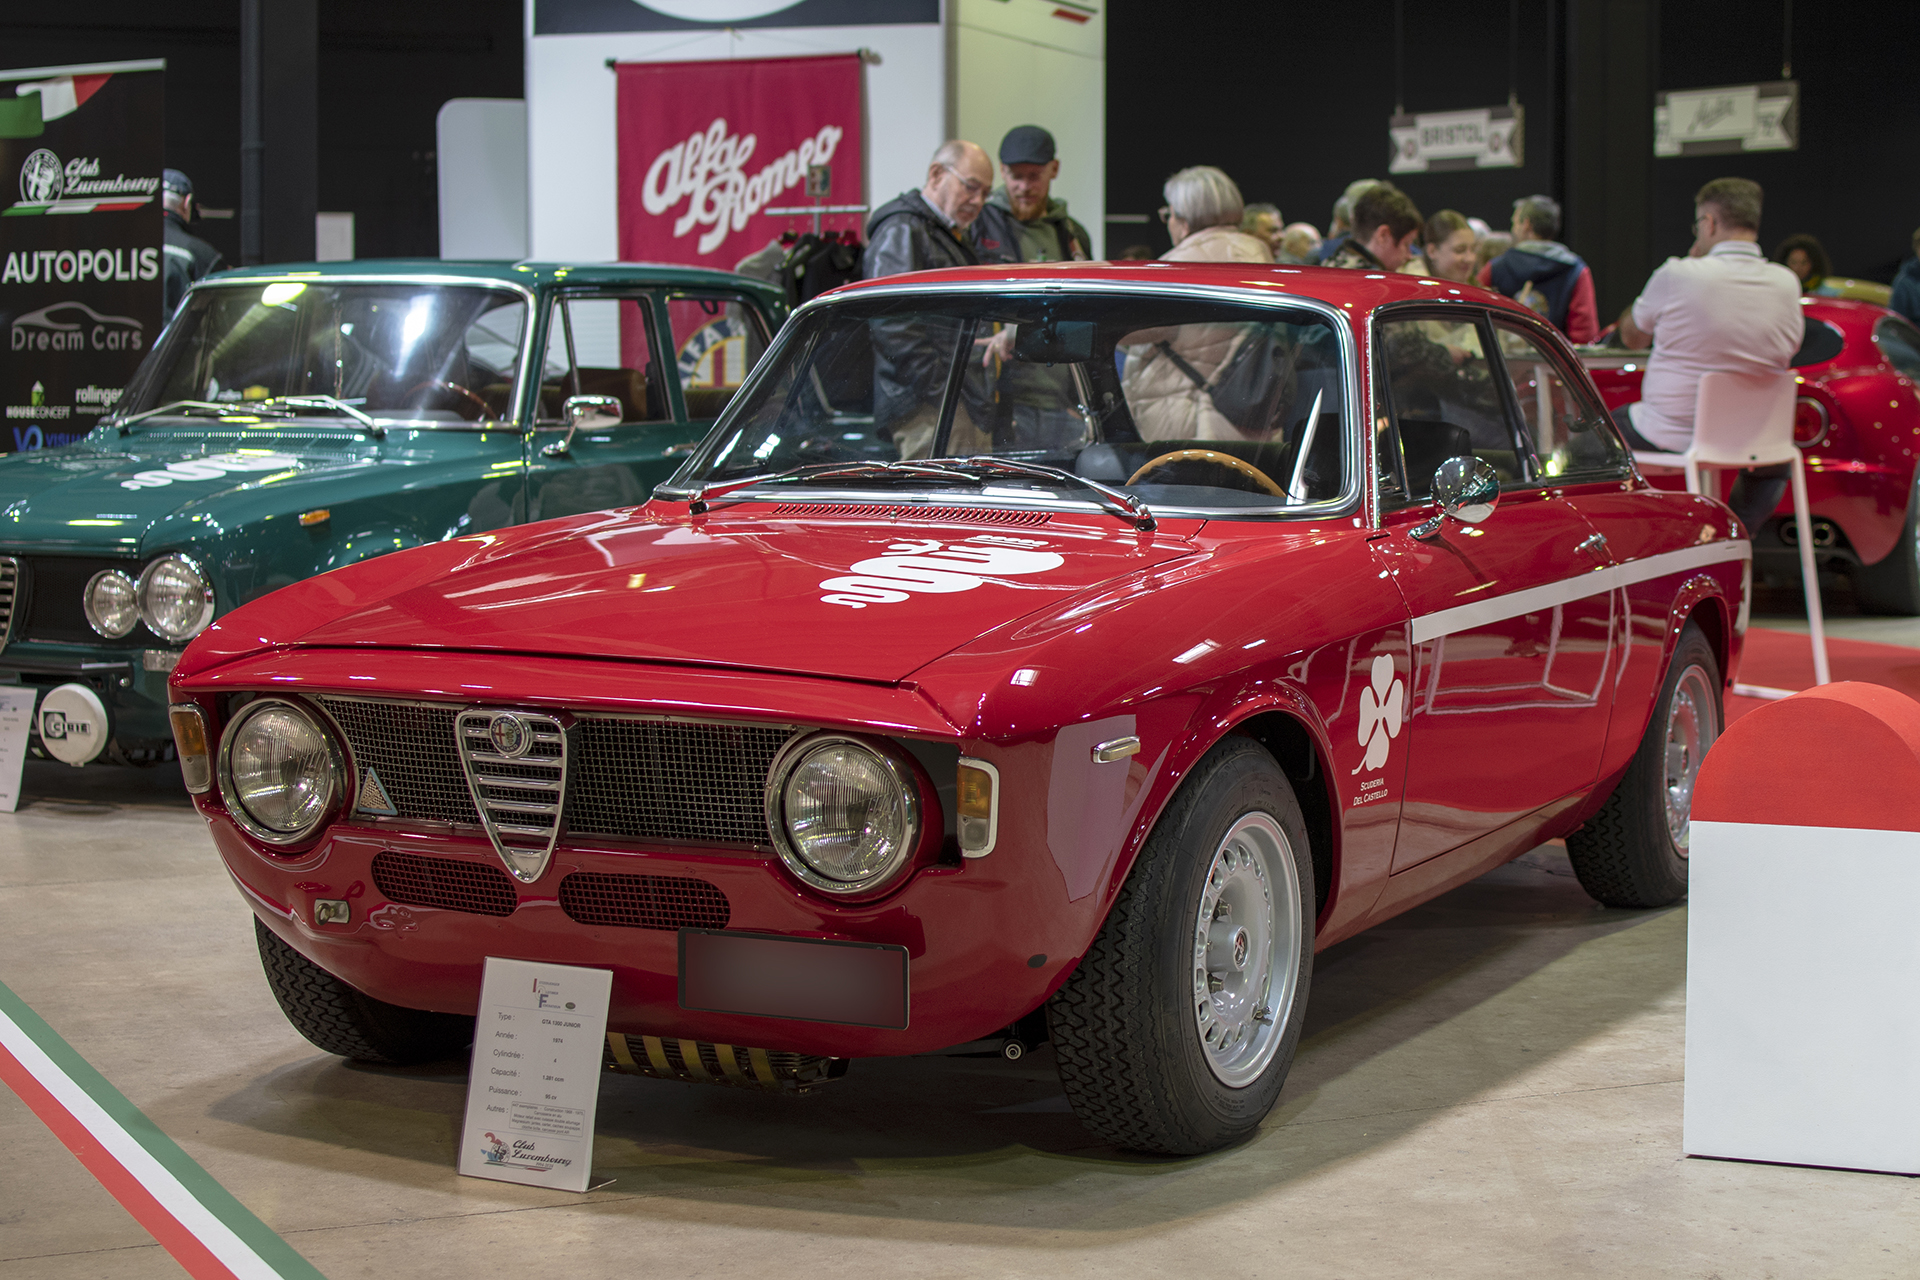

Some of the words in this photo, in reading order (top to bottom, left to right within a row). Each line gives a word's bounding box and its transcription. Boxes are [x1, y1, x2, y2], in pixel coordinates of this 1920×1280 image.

[1422, 123, 1484, 147] BRISTOL
[64, 157, 100, 177] Club
[63, 173, 160, 196] Luxembourg
[642, 118, 756, 238] Alfa
[698, 125, 842, 254] Romeo
[1, 247, 159, 284] AUTOPOLIS
[11, 326, 84, 351] Dream
[92, 324, 143, 351] Cars
[498, 1011, 512, 1020] Type
[563, 1020, 581, 1028] JUNIOR
[495, 1031, 514, 1039] Année
[493, 1049, 521, 1058] Cylindrée
[491, 1067, 517, 1077] Capacité
[489, 1086, 518, 1096] Puissance
[486, 1104, 505, 1113] Autres
[512, 1139, 535, 1150] Club
[511, 1149, 572, 1167] Luxembourg
